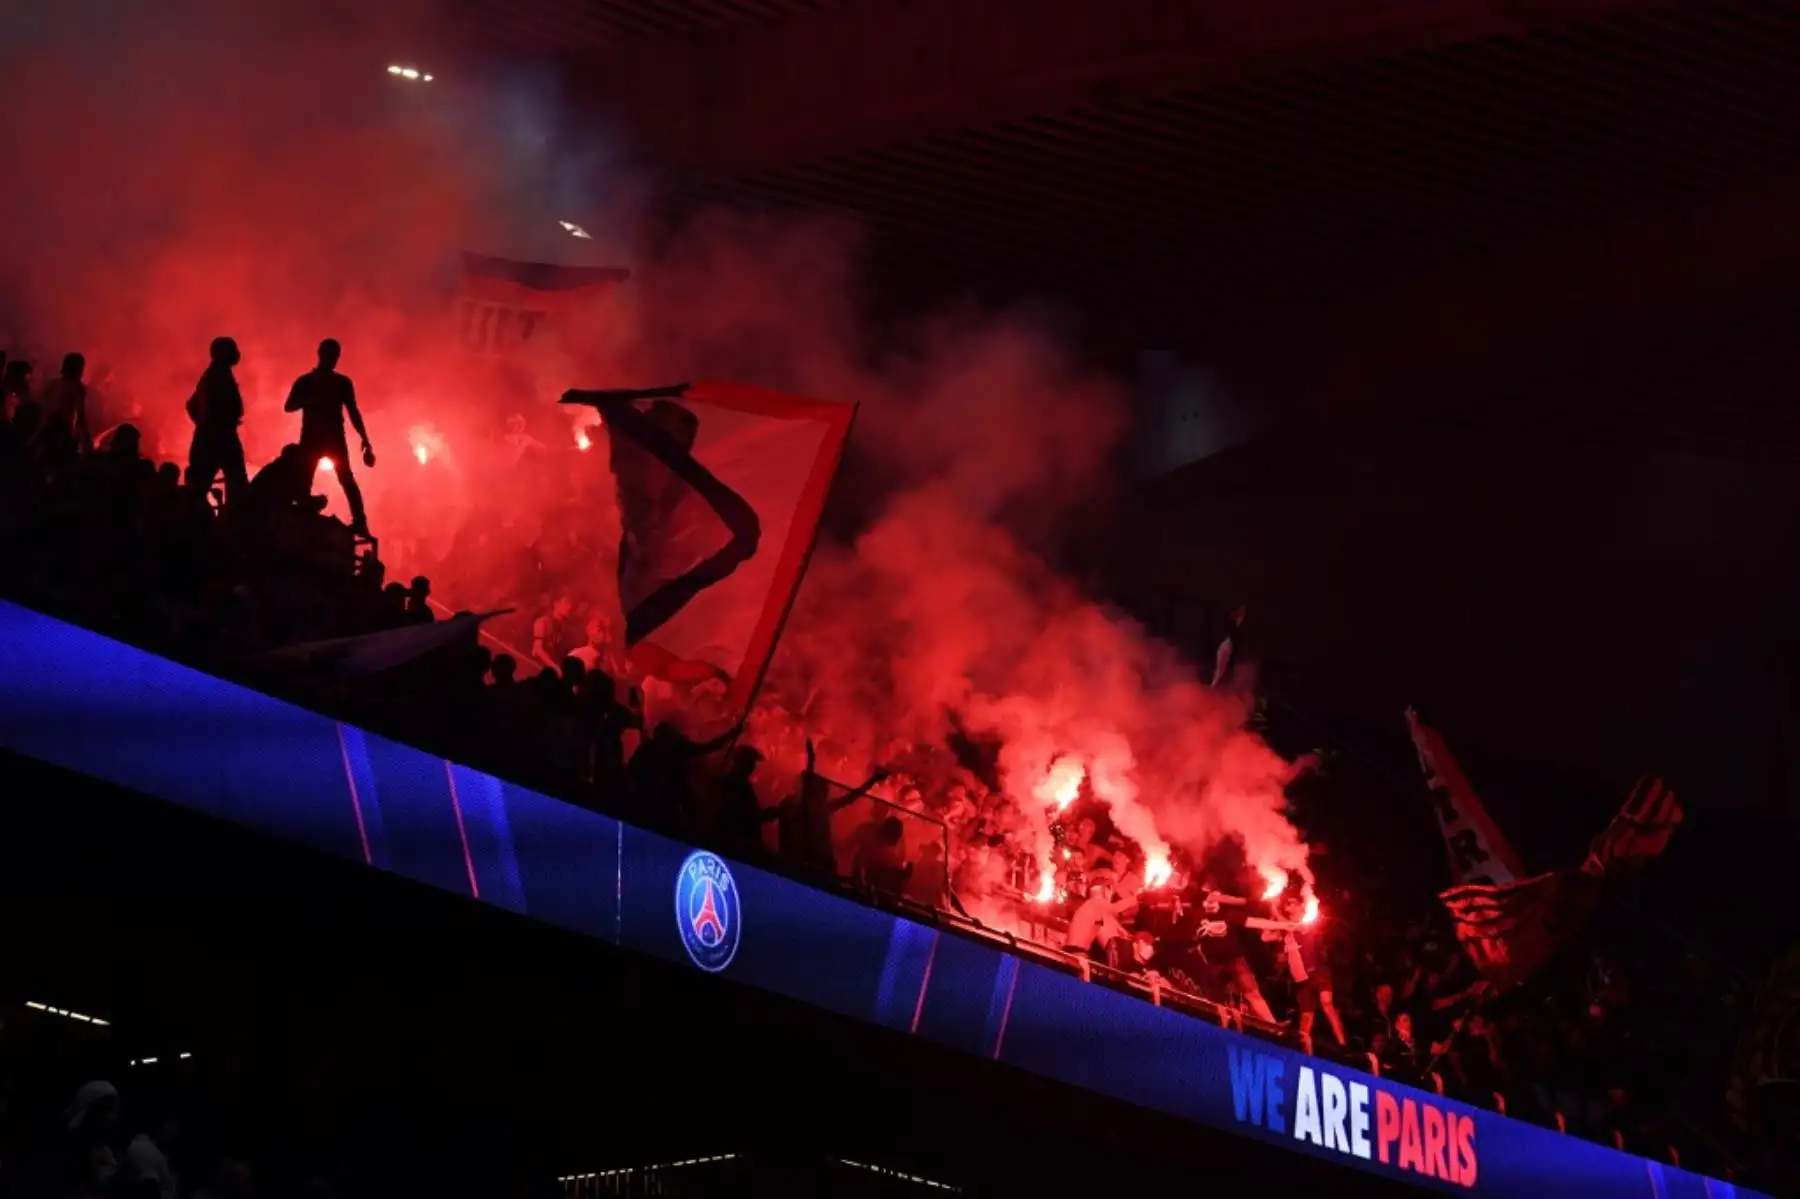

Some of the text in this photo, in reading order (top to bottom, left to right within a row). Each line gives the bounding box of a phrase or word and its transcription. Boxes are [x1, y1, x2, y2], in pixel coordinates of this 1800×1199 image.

[688, 858, 730, 891] PARIS
[1228, 1043, 1477, 1187] WE ARE PARIS
